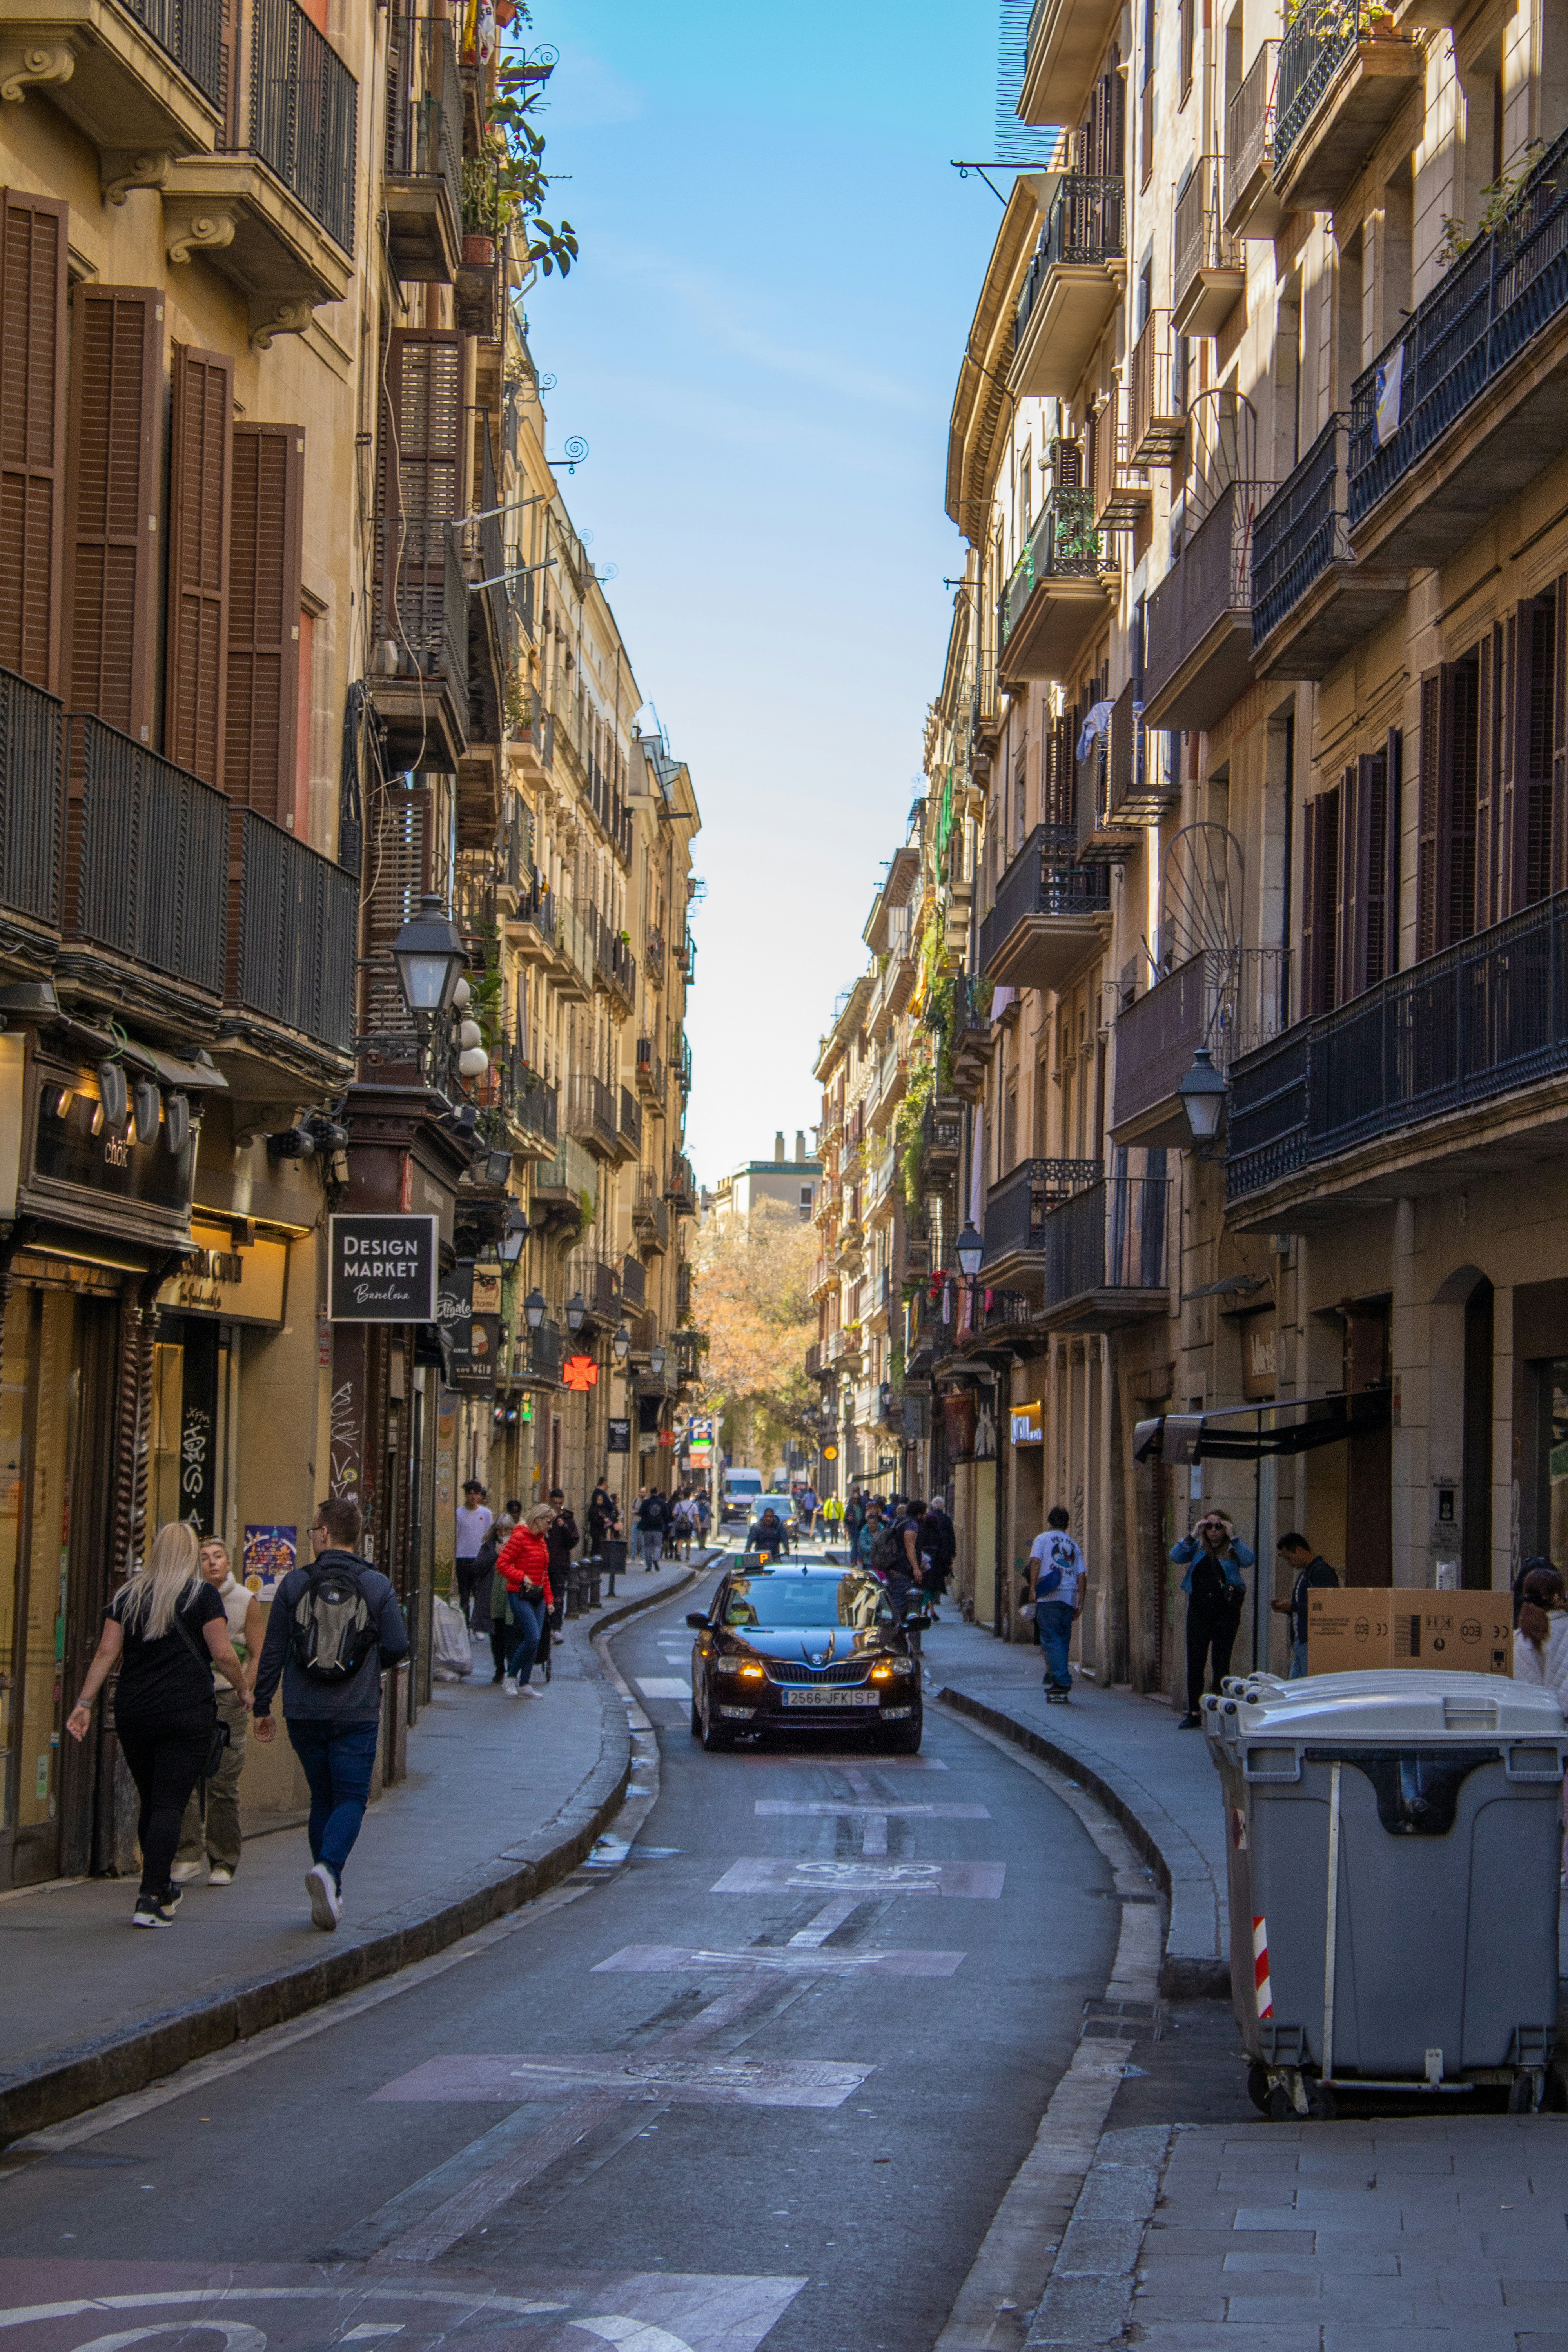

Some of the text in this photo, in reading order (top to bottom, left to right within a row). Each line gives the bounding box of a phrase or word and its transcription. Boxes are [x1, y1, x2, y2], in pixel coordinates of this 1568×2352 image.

[105, 1136, 129, 1168] chök
[343, 1236, 418, 1256] DESIGN
[343, 1261, 419, 1277] MARKET
[353, 1283, 410, 1304] Barcelona
[1462, 1625, 1509, 1639] ECO CE
[791, 1693, 822, 1704] 2566
[826, 1693, 848, 1704] JFK
